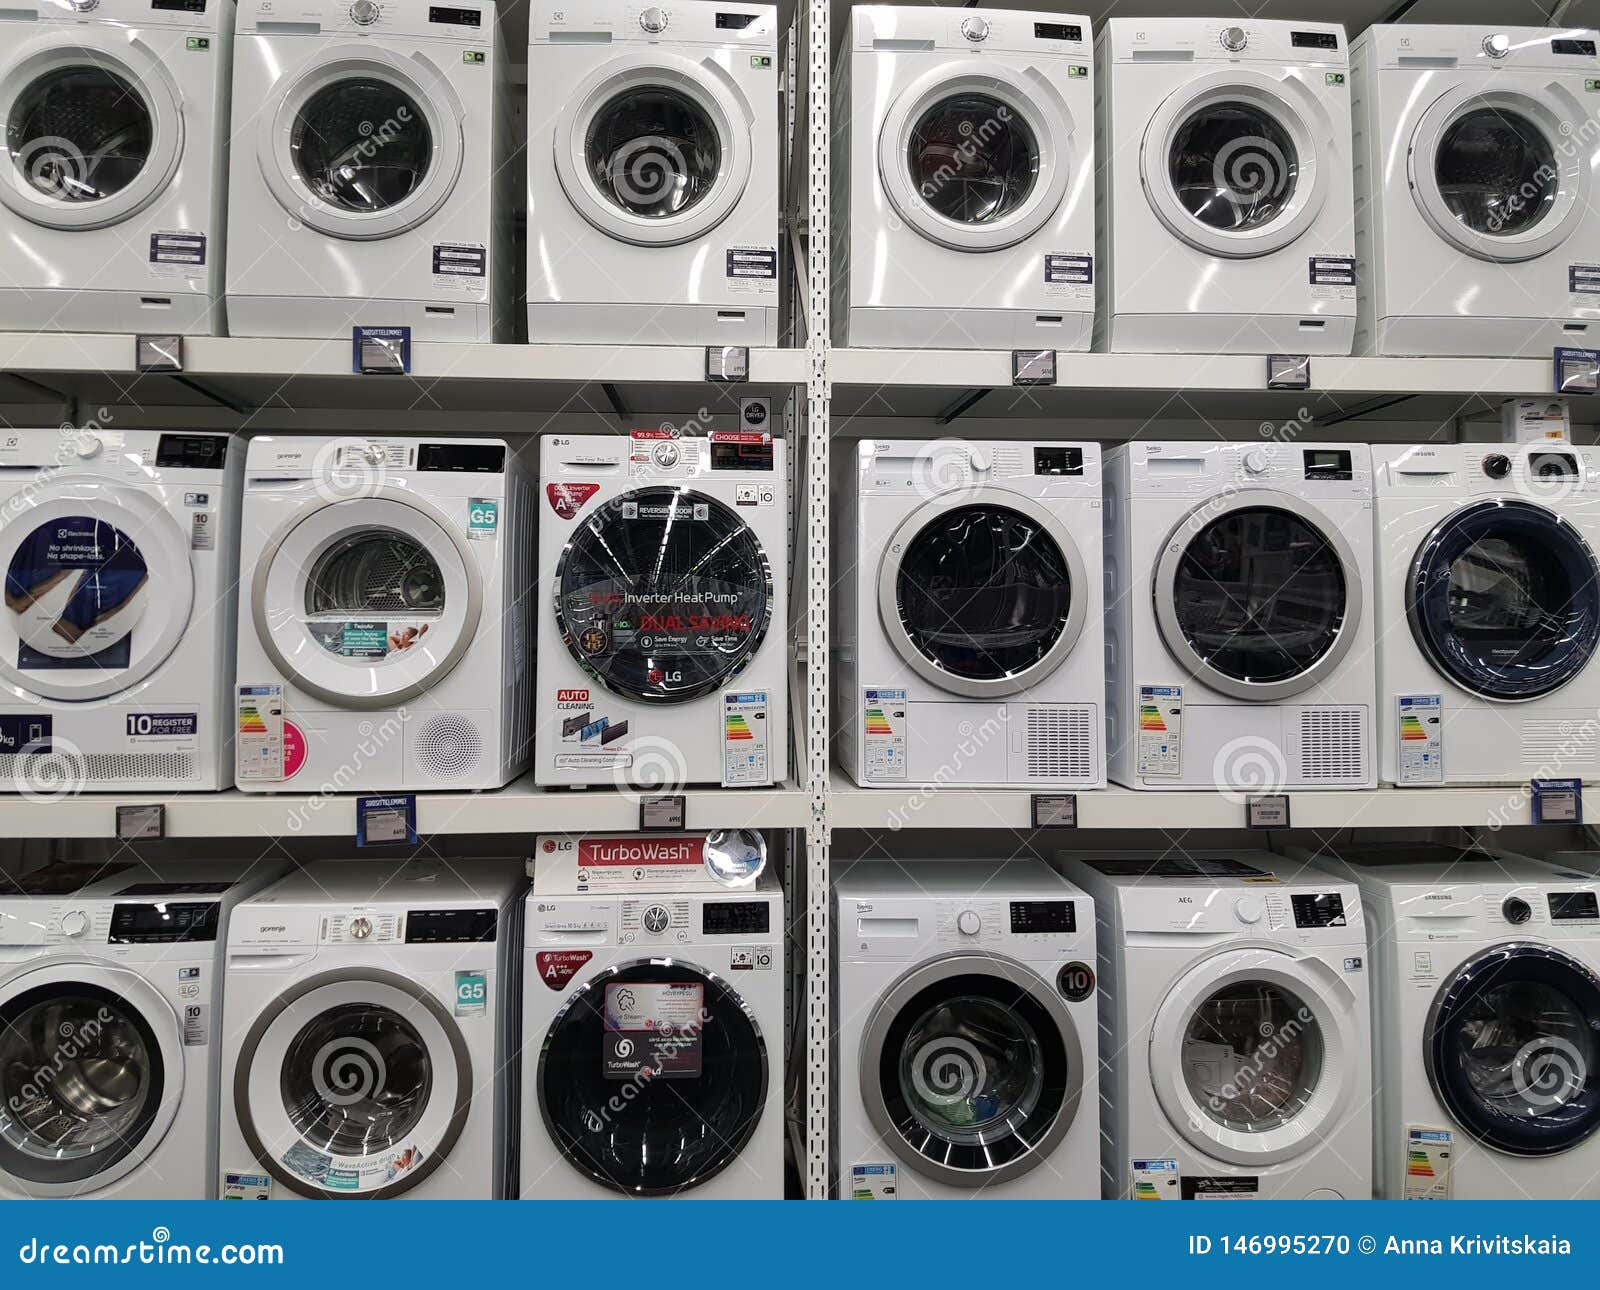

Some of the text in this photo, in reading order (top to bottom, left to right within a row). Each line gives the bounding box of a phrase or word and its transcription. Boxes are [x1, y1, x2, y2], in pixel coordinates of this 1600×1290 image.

[714, 432, 740, 441] CHOOSE
[194, 513, 208, 524] 10
[469, 508, 496, 525] G5
[48, 544, 60, 553] No
[47, 552, 59, 562] No
[624, 591, 673, 605] Inverter
[640, 616, 684, 632] DUAL
[664, 671, 683, 682] LG
[559, 691, 588, 701] AUTO
[557, 702, 595, 710] CLEANING
[128, 716, 193, 735] 10 REGISTER
[153, 728, 192, 736] FOR FREE
[558, 842, 572, 851] LG
[1178, 896, 1193, 904] AEG
[260, 924, 287, 935] gorenje
[1064, 971, 1088, 994] 10
[458, 983, 485, 1000] G5
[186, 1006, 200, 1018] 10
